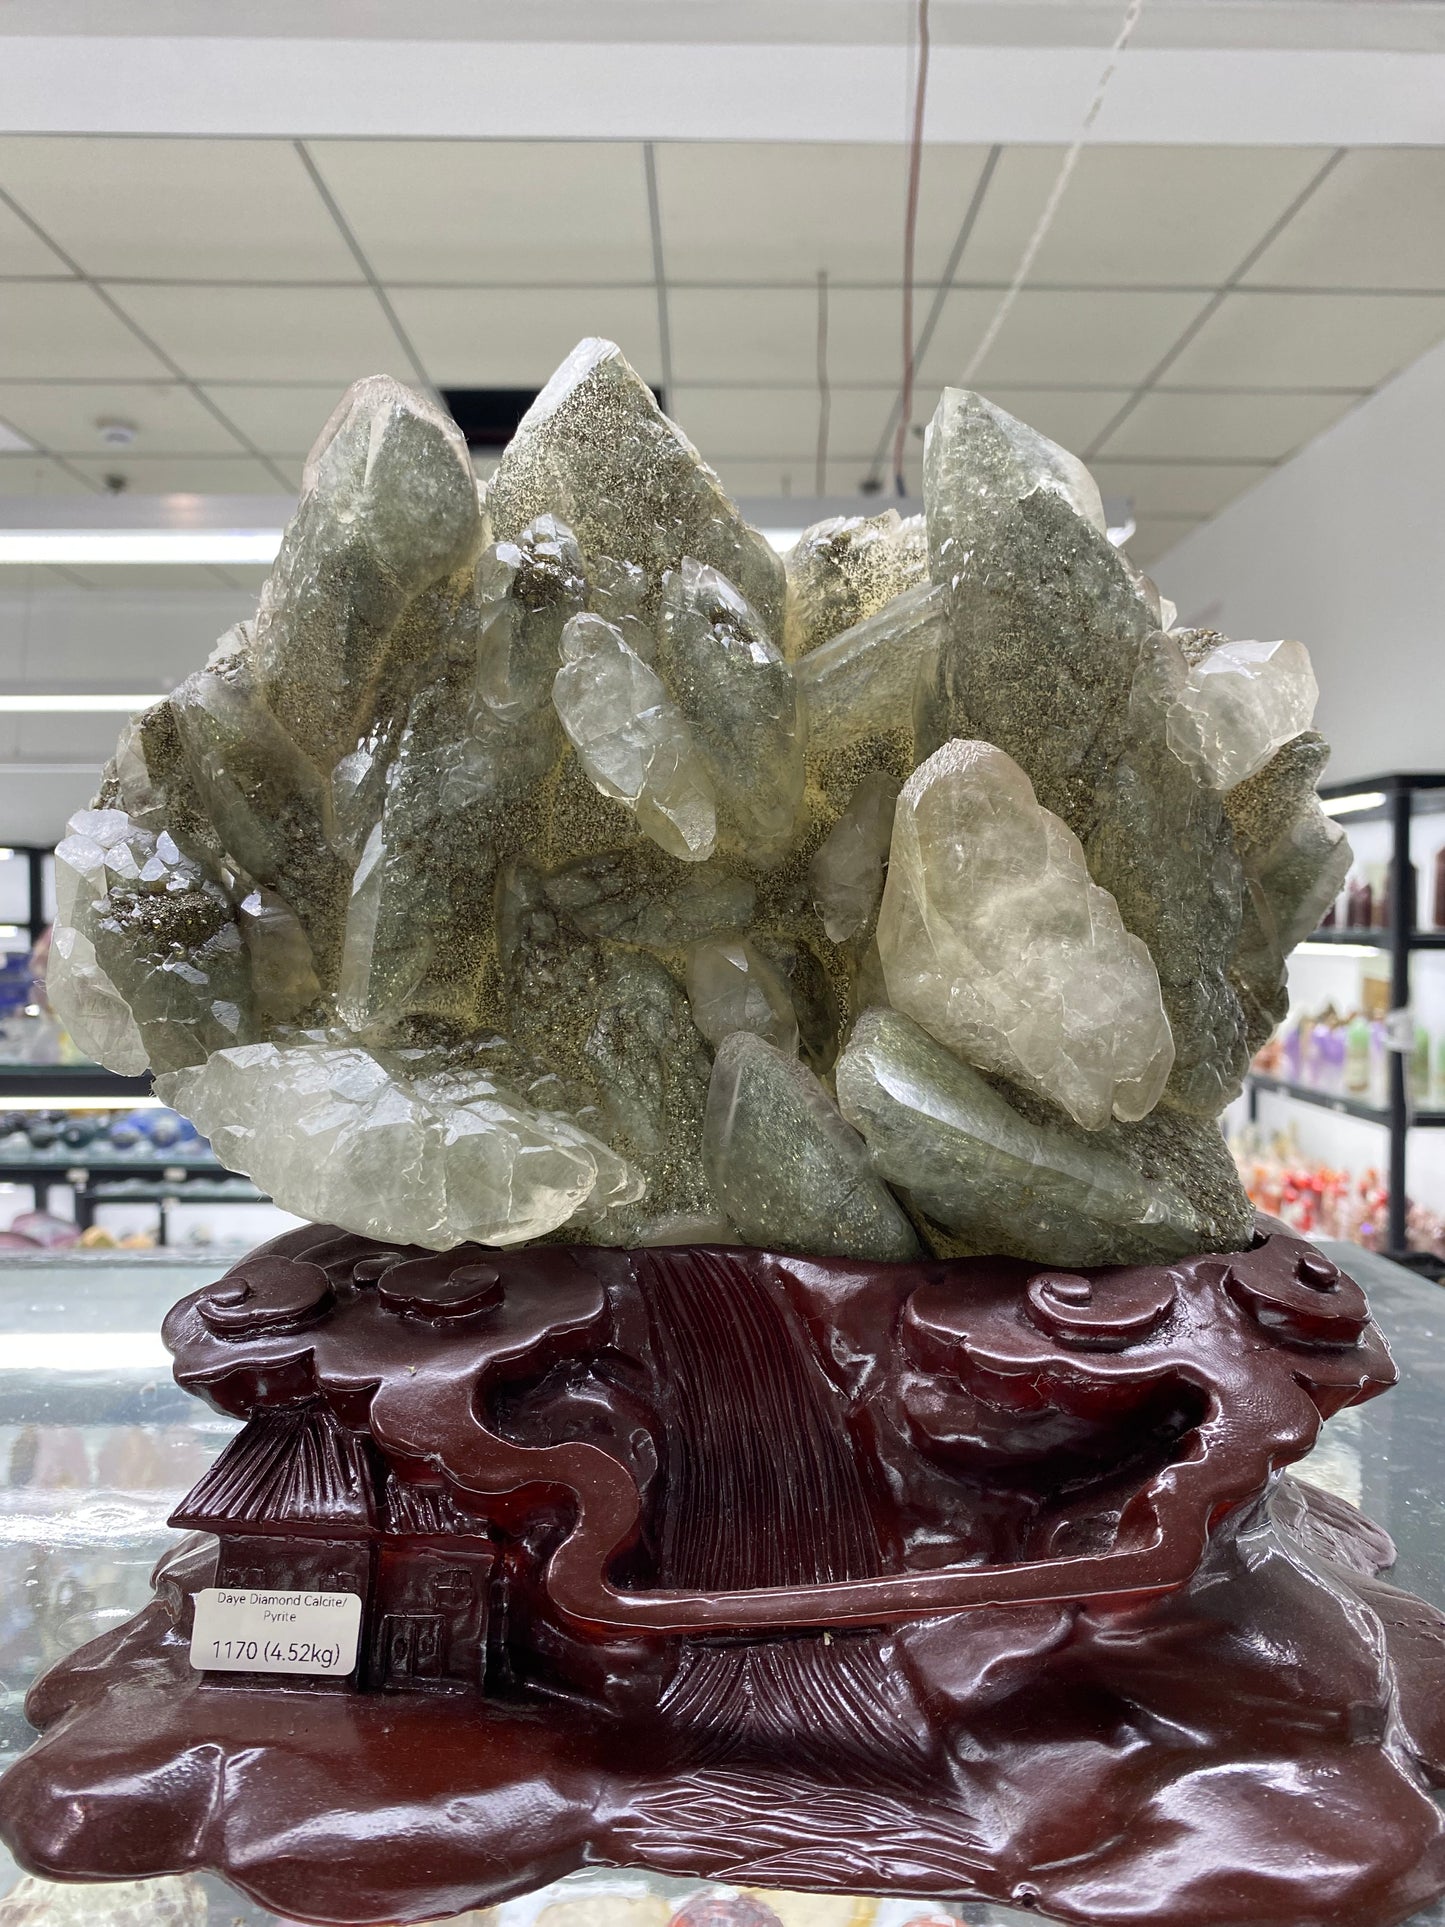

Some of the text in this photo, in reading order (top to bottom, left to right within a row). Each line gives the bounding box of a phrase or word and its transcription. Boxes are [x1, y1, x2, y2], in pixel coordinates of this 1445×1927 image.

[217, 1592, 348, 1608] Daye Diamond Calcite/
[264, 1610, 297, 1623] Pyrite
[213, 1641, 340, 1669] 1170 (4.52kg)
